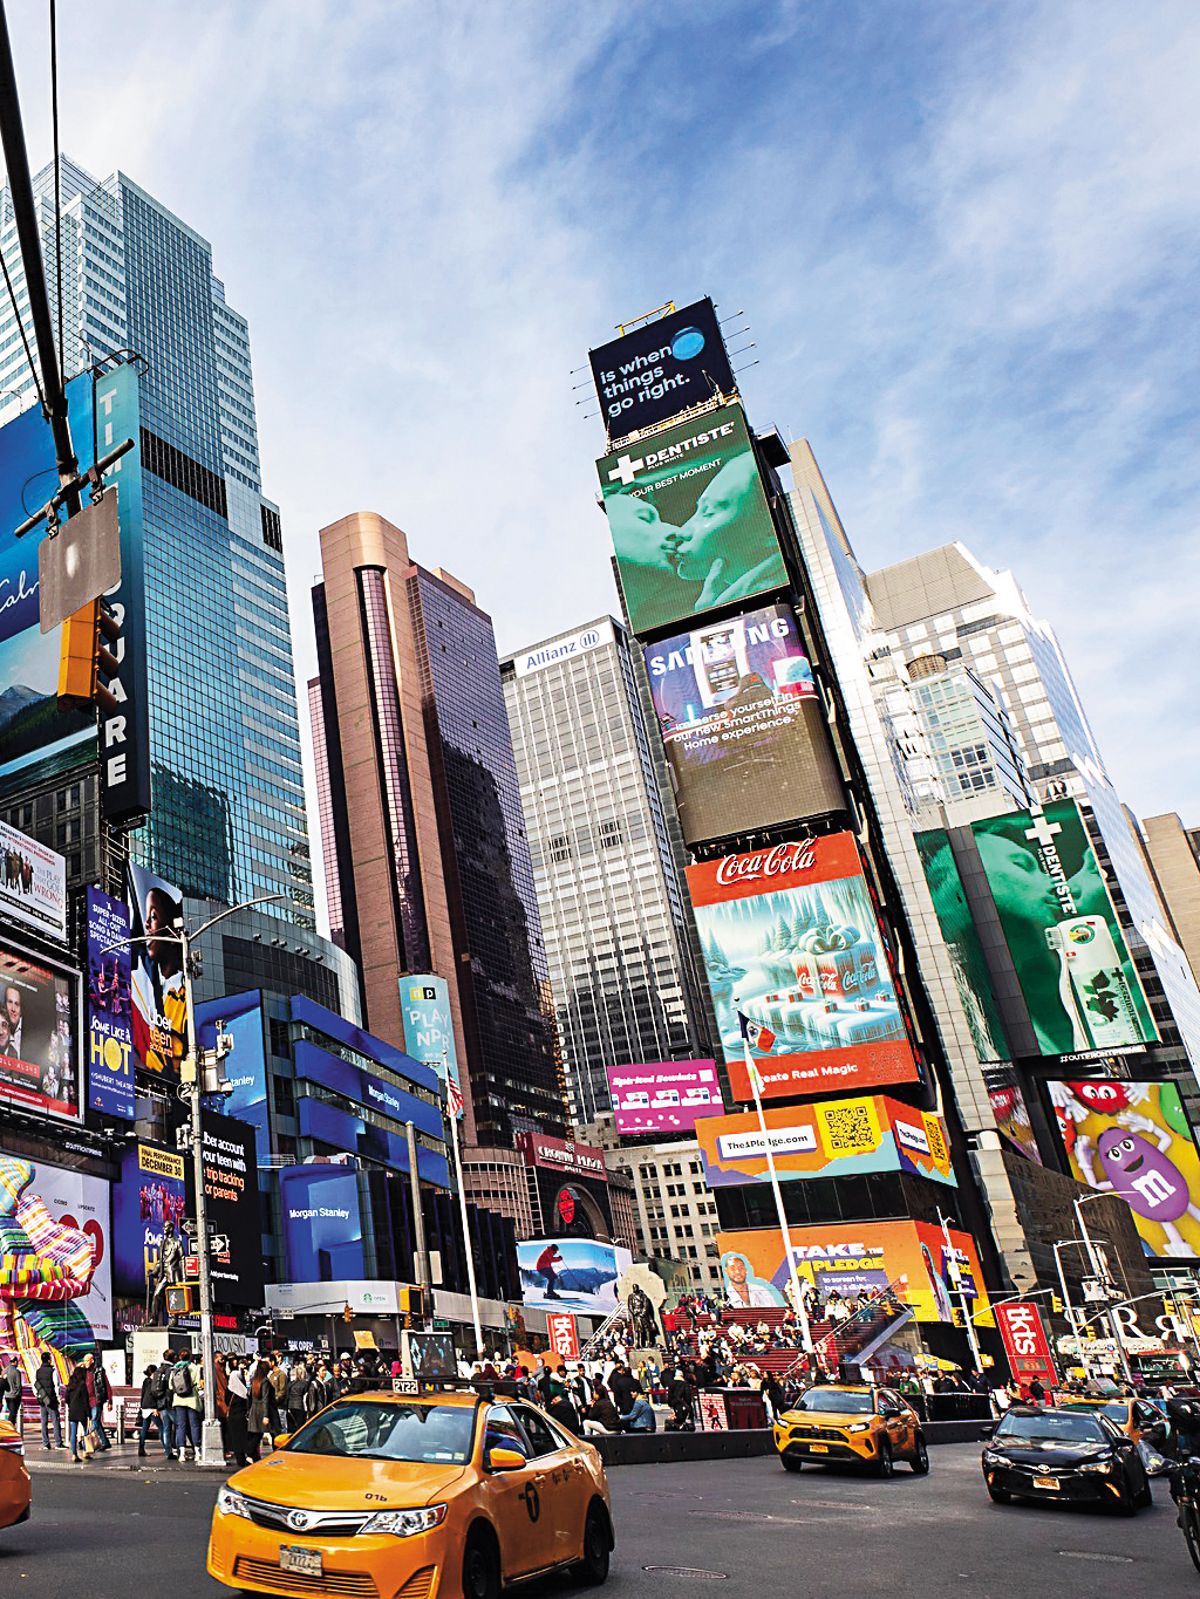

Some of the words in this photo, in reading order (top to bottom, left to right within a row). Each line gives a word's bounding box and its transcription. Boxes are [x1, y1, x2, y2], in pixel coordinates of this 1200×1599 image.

[599, 371, 616, 385] is
[619, 345, 672, 376] when
[603, 366, 664, 399] things
[608, 397, 634, 418] go
[638, 373, 690, 404] right.
[629, 484, 655, 498] YOUR
[655, 477, 678, 492] BEST
[679, 458, 722, 480] MOMENT
[647, 461, 664, 470] PLUS
[526, 641, 578, 669] Allianz
[729, 693, 781, 717] yourself
[683, 734, 719, 751] Home
[721, 716, 795, 743] experience.
[694, 721, 722, 737] new
[715, 837, 815, 886] Coca-Cola
[90, 1015, 110, 1035] SOME
[111, 1025, 125, 1041] LIKE
[90, 1030, 132, 1076] HOT
[230, 1076, 255, 1088] tanley
[760, 1070, 790, 1084] reate
[792, 1066, 819, 1081] Real
[821, 1062, 859, 1080] Magic
[142, 1156, 173, 1174] DECEMBER
[174, 1165, 182, 1177] 30
[289, 1208, 319, 1220] Morgan
[319, 1207, 350, 1219] Stanley
[792, 1243, 866, 1259] TAKE
[813, 1257, 885, 1272] PLEDGE
[553, 1316, 570, 1360] tkts
[1006, 1306, 1037, 1355] tkts
[394, 1380, 418, 1393] 2Y22
